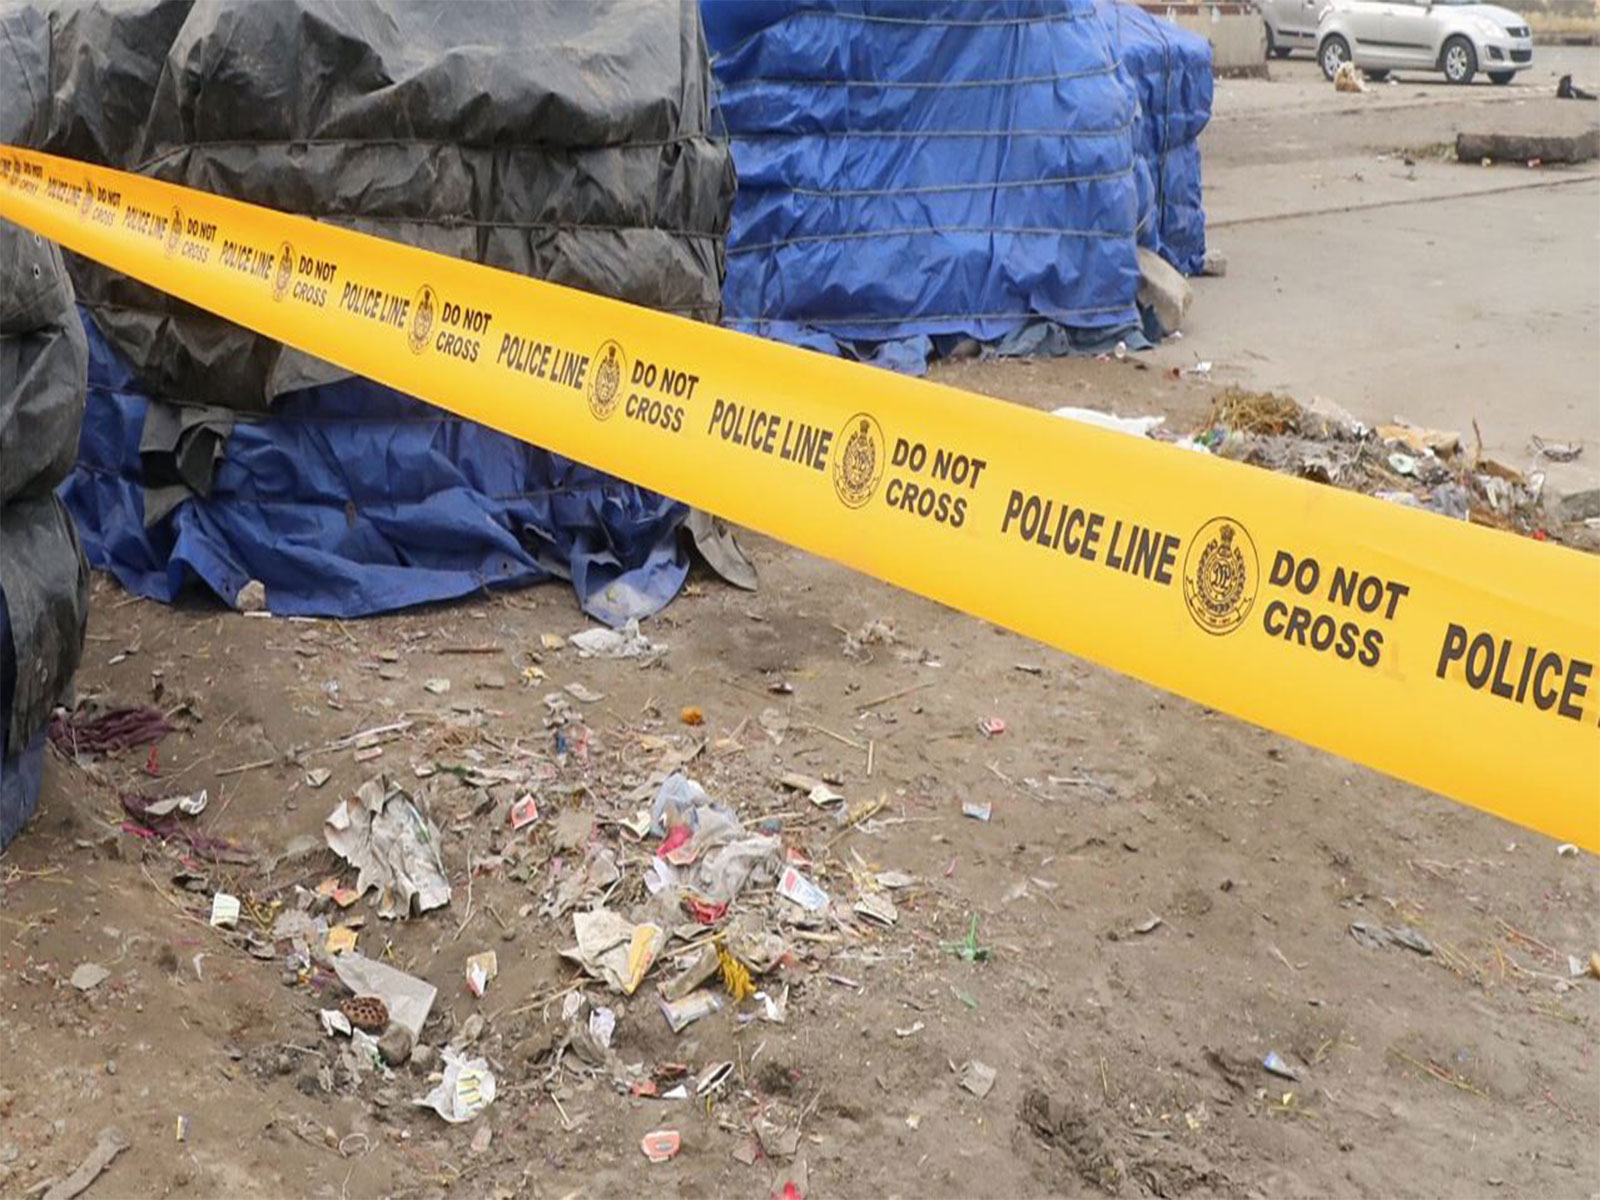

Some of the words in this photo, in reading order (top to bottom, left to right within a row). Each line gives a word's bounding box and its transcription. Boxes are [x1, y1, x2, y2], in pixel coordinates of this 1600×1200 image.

[97, 186, 107, 203] DO
[107, 189, 121, 209] NOT
[122, 206, 150, 236] POLICE
[148, 214, 168, 240] LINE
[187, 218, 199, 236] DO
[200, 222, 217, 242] NOT
[182, 241, 209, 263] CROSS
[220, 240, 252, 272] POLICE
[250, 250, 274, 280] LINE
[299, 255, 313, 276] DO
[314, 261, 337, 283] NOT
[293, 281, 327, 308] CROSS
[339, 281, 382, 319] POLICE
[379, 294, 410, 328] LINE
[442, 302, 460, 326] DO
[463, 308, 492, 335] NOT
[436, 331, 480, 363] CROSS
[496, 333, 551, 378] POLICE
[550, 349, 589, 390] LINE
[631, 359, 657, 388] DO
[660, 368, 699, 400] NOT
[625, 394, 684, 432] CROSS
[708, 399, 781, 454] POLICE
[780, 420, 833, 471] LINE
[891, 438, 927, 472] DO
[931, 449, 986, 489] NOT
[886, 478, 967, 528] CROSS
[1001, 490, 1104, 561] POLICE
[1106, 520, 1181, 585] LINE
[1269, 550, 1320, 595] DO
[1328, 566, 1410, 620] NOT
[1263, 601, 1384, 667] CROSS
[1436, 622, 1593, 721] POLICE
